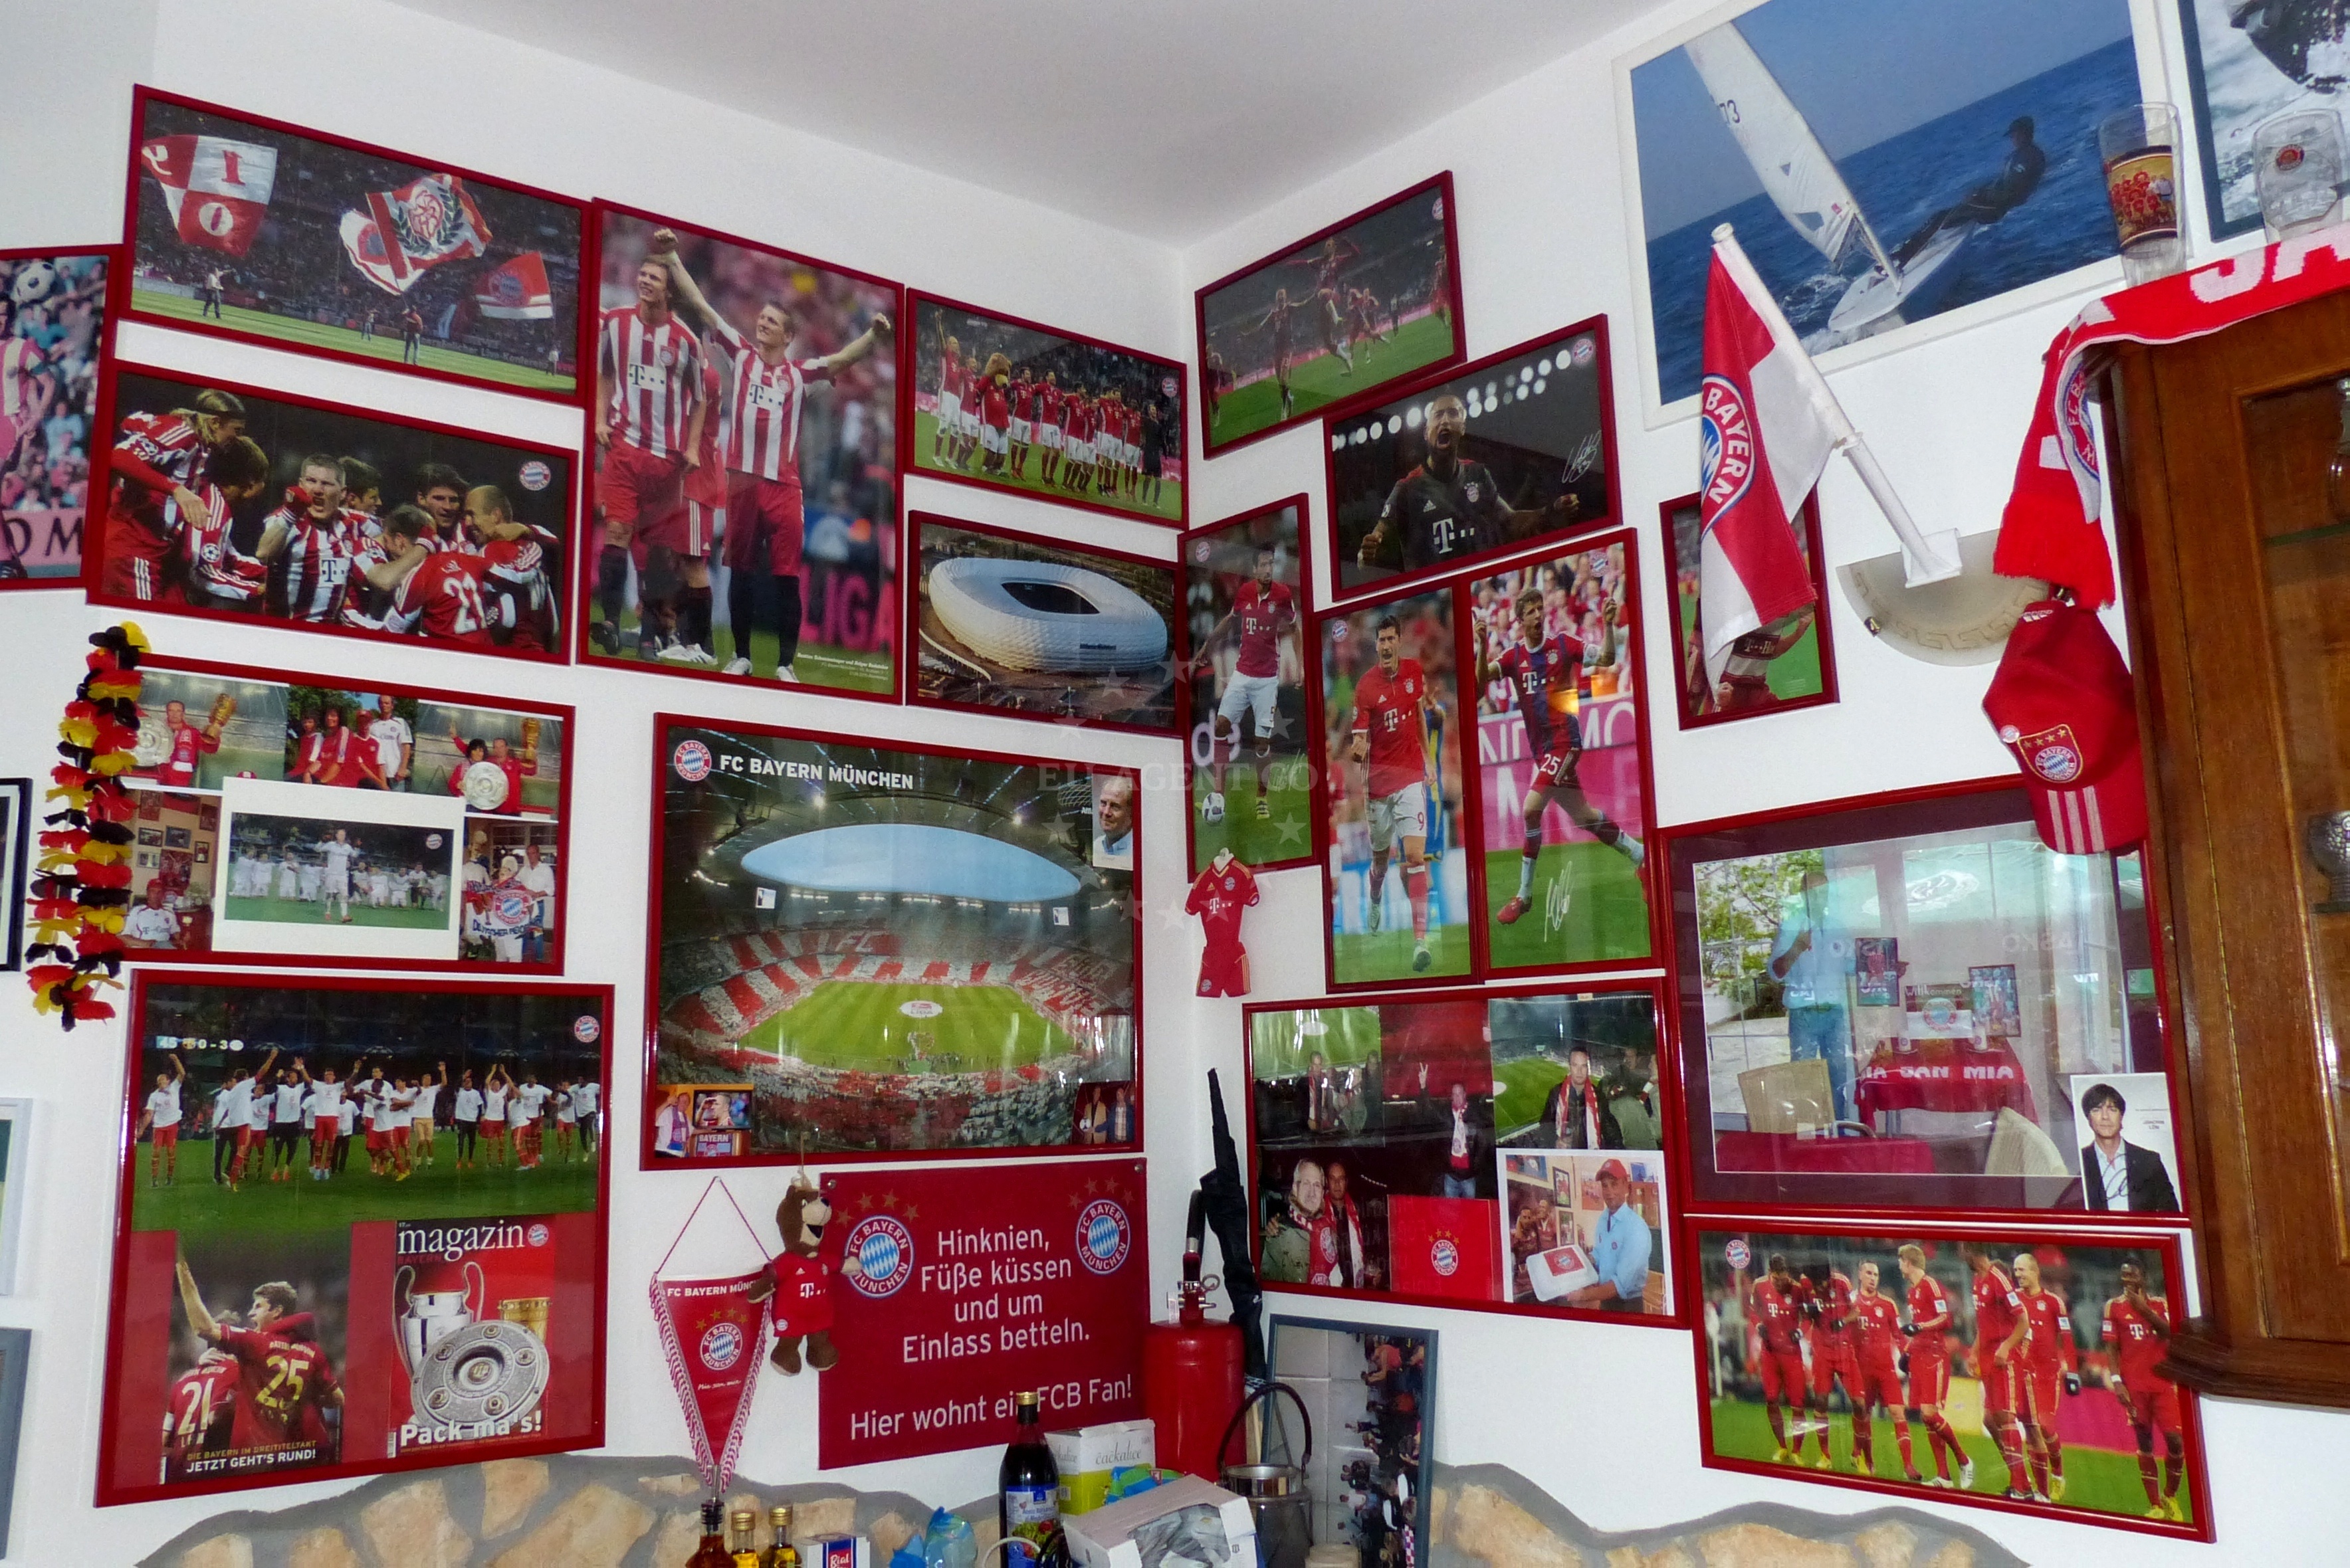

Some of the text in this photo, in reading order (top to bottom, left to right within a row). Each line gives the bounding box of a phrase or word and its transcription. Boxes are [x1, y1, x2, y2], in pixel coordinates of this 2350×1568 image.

[1705, 387, 1749, 504] BAYERN
[720, 755, 914, 789] FC BAYERN MÜNCHEN
[1540, 753, 1561, 775] 25
[1861, 1066, 2014, 1080] IA SAN MIA
[699, 1133, 729, 1142] BAYERN
[1080, 1217, 1090, 1234] FC
[1089, 1204, 1126, 1230] BAYERN
[397, 1220, 525, 1262] magazin
[850, 1234, 863, 1253] FC
[863, 1221, 908, 1250] BAYERN
[938, 1225, 1049, 1257] Hinknien,
[667, 1288, 681, 1297] FC
[685, 1286, 727, 1296] BAYERN
[922, 1257, 1072, 1295] Füße küssen
[954, 1293, 1043, 1323] und um
[704, 1335, 713, 1346] FC
[712, 1325, 741, 1341] BAYERN
[903, 1317, 1090, 1363] Einlass betteln.
[255, 1355, 310, 1409] 25
[177, 1377, 215, 1435] 21
[851, 1374, 1132, 1440] Hier wohnt ei FCB Fan!
[400, 1419, 463, 1447] Pack
[473, 1410, 542, 1438] ma's!
[186, 1448, 316, 1473] JETZT GEHT'S RUND!
[203, 1450, 239, 1459] BAYERN
